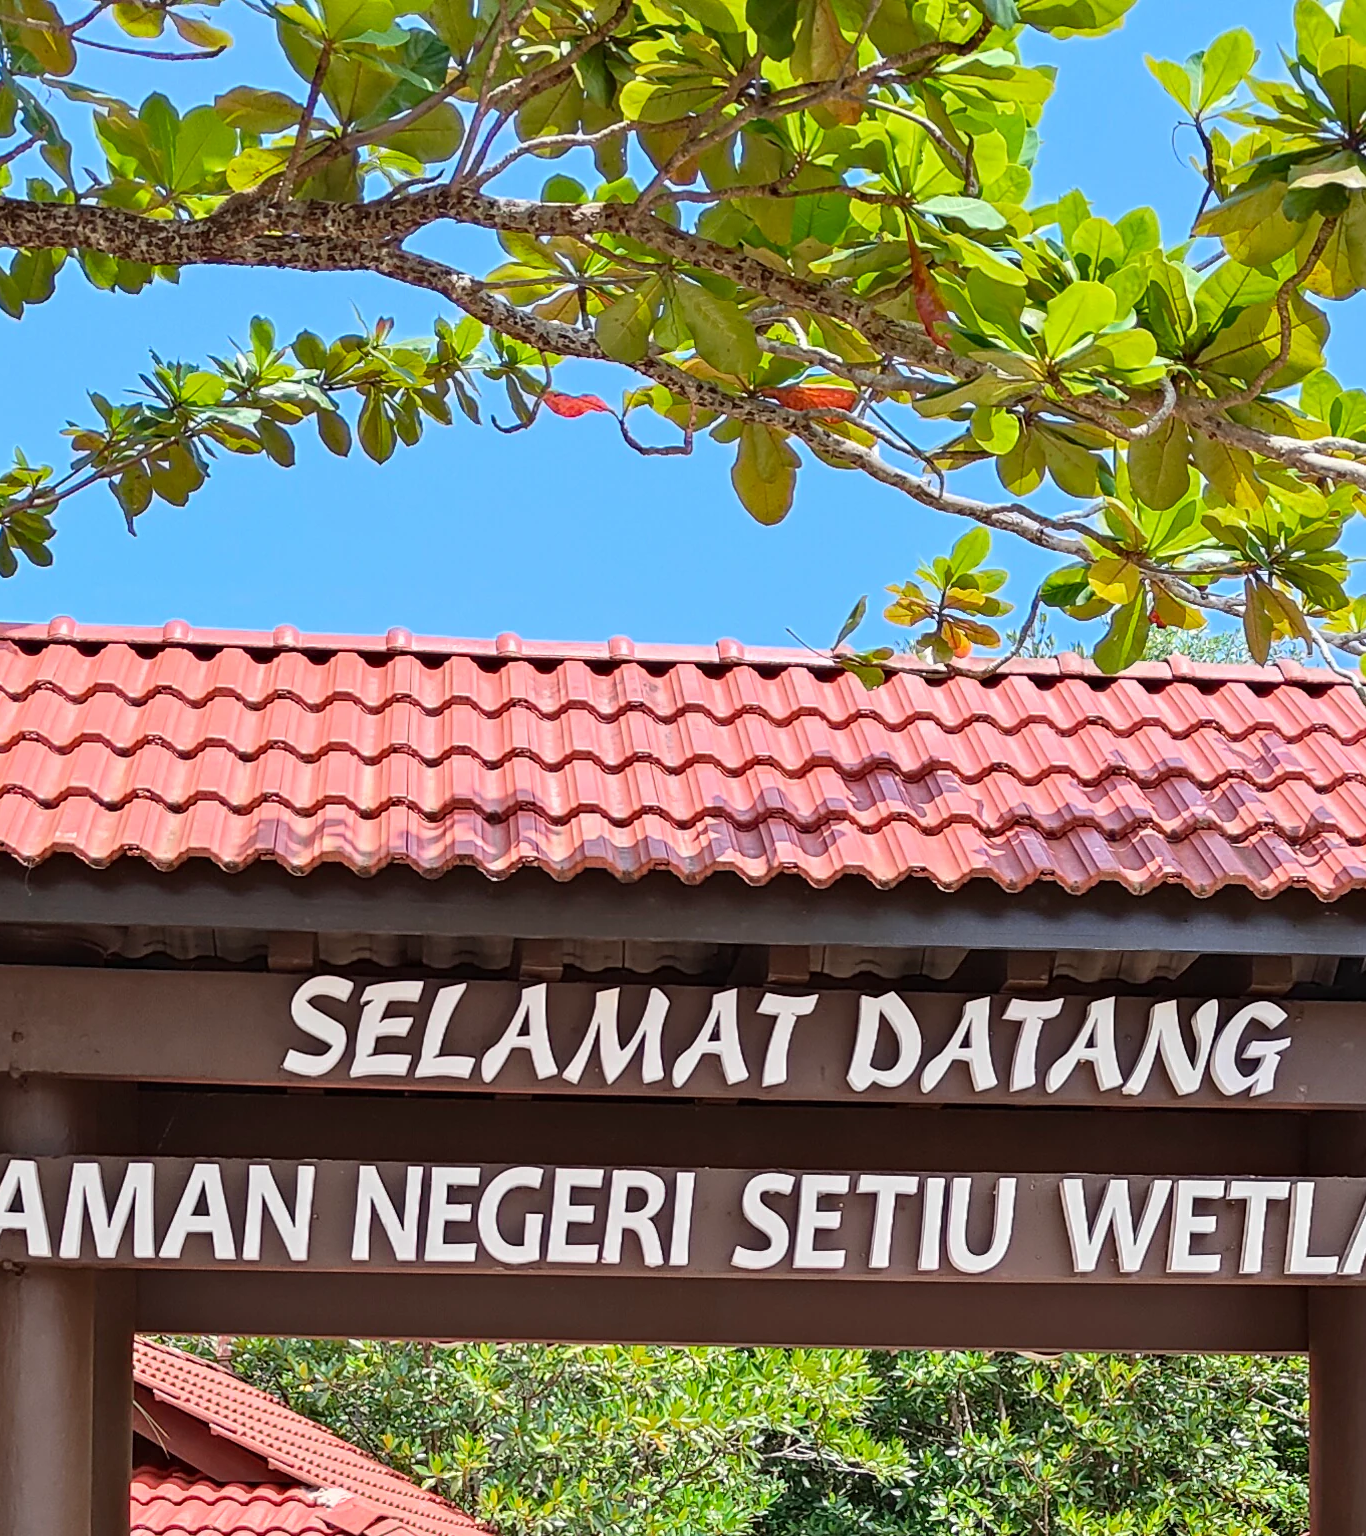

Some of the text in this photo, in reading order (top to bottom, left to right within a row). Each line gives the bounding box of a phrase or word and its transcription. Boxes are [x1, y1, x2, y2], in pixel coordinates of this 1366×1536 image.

[282, 974, 1291, 1098] SELAMAT DATANG
[350, 1164, 695, 1268] NEGERI
[730, 1171, 1017, 1275] SETIU
